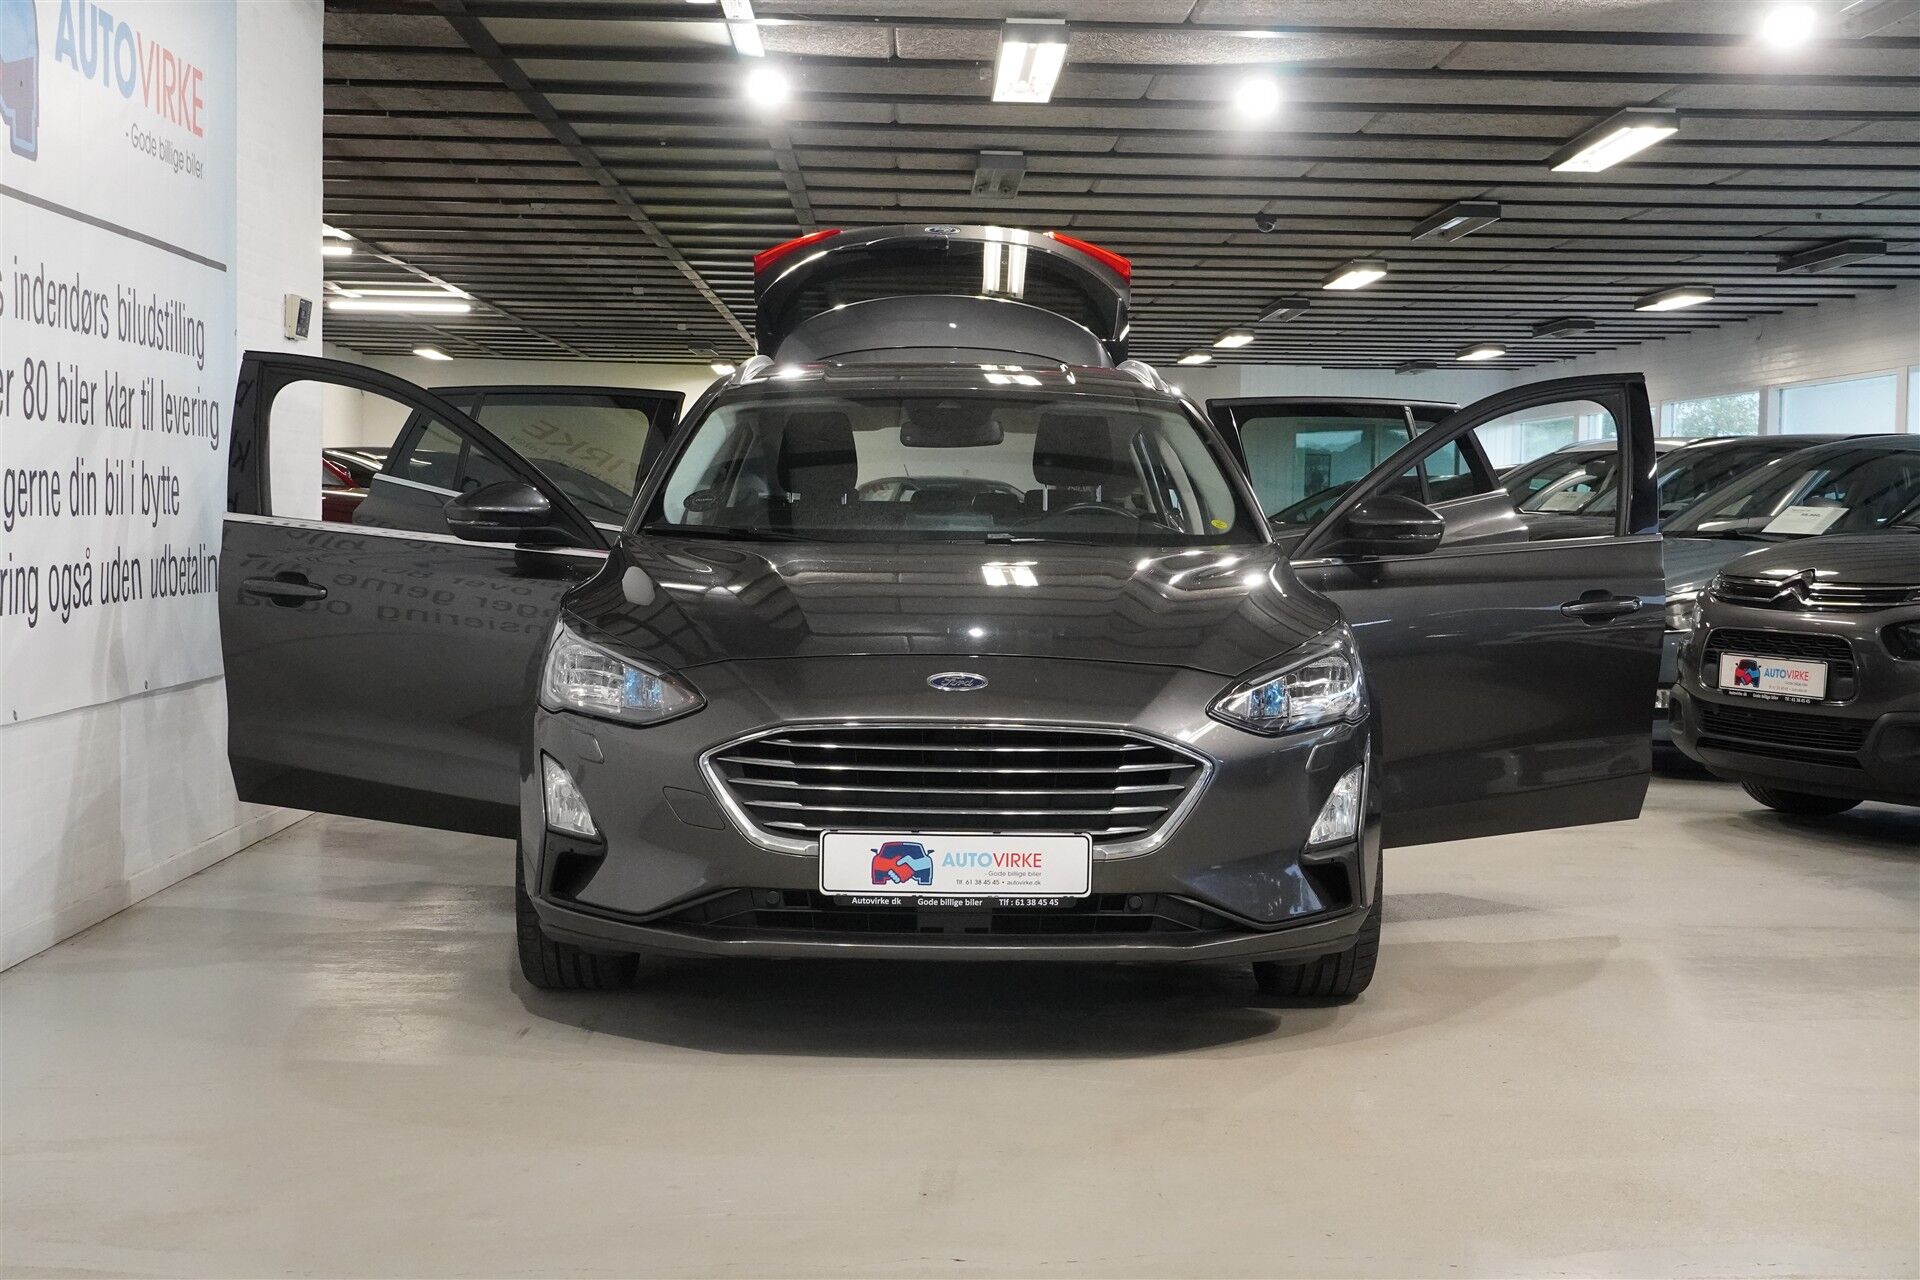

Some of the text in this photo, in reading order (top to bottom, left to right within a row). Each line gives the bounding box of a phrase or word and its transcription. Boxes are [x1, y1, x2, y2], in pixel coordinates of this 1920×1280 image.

[55, 0, 204, 138] AUTOVIRKE
[131, 122, 157, 157] Gode
[159, 136, 184, 173] billige
[186, 149, 204, 180] biler
[14, 255, 109, 339] indendørs
[117, 283, 205, 371] biludstilling
[23, 357, 48, 421] 80
[57, 361, 97, 426] biler
[105, 370, 135, 429] klar
[141, 376, 154, 431] til
[161, 379, 219, 451] levering
[4, 456, 180, 533] gerne din bil i bytte
[48, 547, 93, 624] også
[100, 546, 143, 605] uden
[1764, 668, 1809, 682] AUTOVIRKE
[942, 852, 1042, 868] AUTOVIRKE
[1007, 870, 1027, 878] billige
[851, 897, 902, 905] Autovirke dk
[917, 898, 983, 907] Gode billige biler
